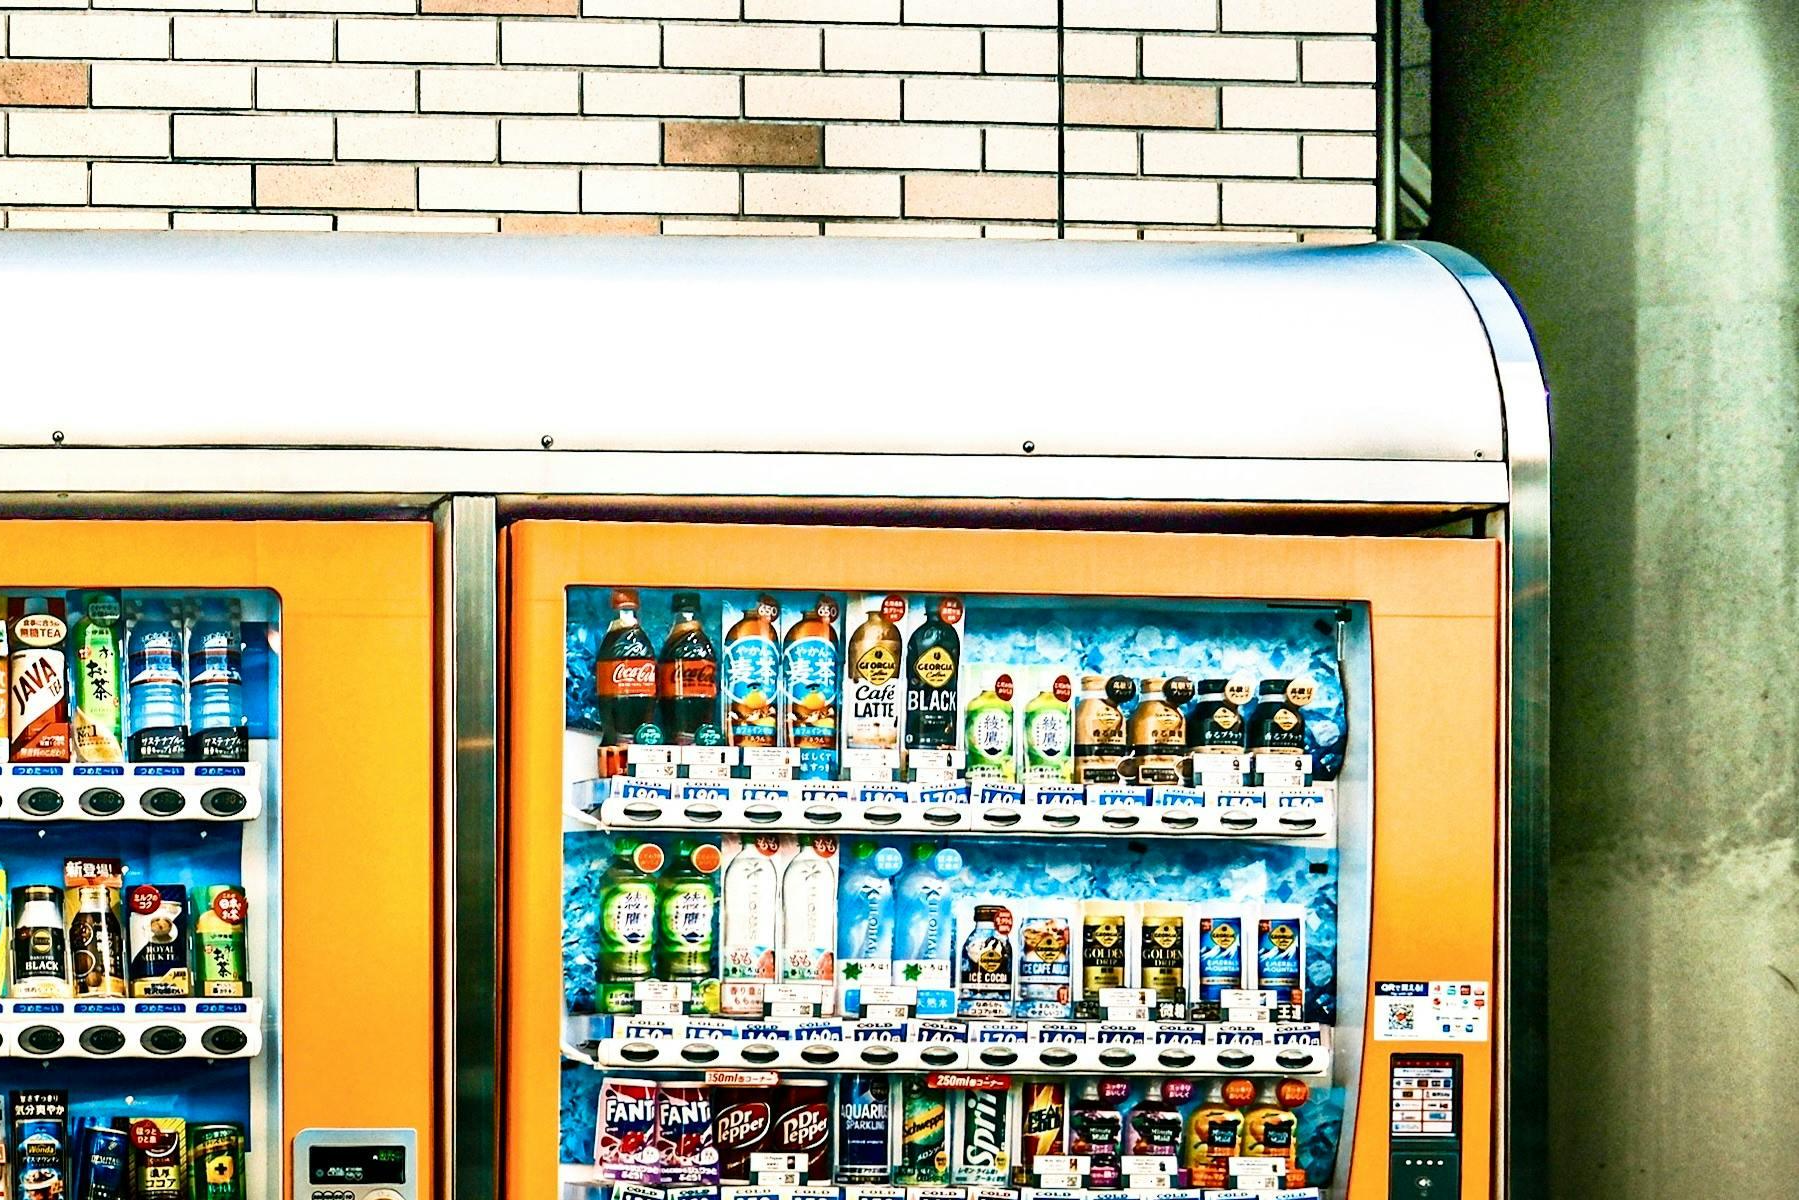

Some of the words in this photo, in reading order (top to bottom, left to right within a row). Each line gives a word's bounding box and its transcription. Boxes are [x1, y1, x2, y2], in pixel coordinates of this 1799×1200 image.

[758, 605, 777, 617] 650
[729, 659, 777, 685] 麦茶
[787, 660, 835, 686] 麦茶
[859, 662, 895, 670] GEORGIA
[917, 663, 953, 671] GEORGIA
[13, 657, 57, 716] JAVA
[49, 680, 63, 697] TEA
[856, 685, 895, 701] Café
[908, 690, 957, 711] BLACK
[854, 703, 895, 718] LATTE
[66, 860, 113, 878] 新登場!
[1084, 948, 1124, 959] GOLDEN
[1142, 948, 1183, 960] GOLDEN
[25, 961, 59, 971] BLACK
[968, 973, 983, 983] ICE
[15, 1104, 64, 1116] 気分爽やか
[730, 1110, 752, 1126] Dr
[798, 1110, 820, 1126] Dr
[718, 1116, 765, 1144] Pepper
[783, 1117, 828, 1145] Pepper
[150, 1168, 170, 1178] 濃厚
[145, 1179, 177, 1188] ココア
